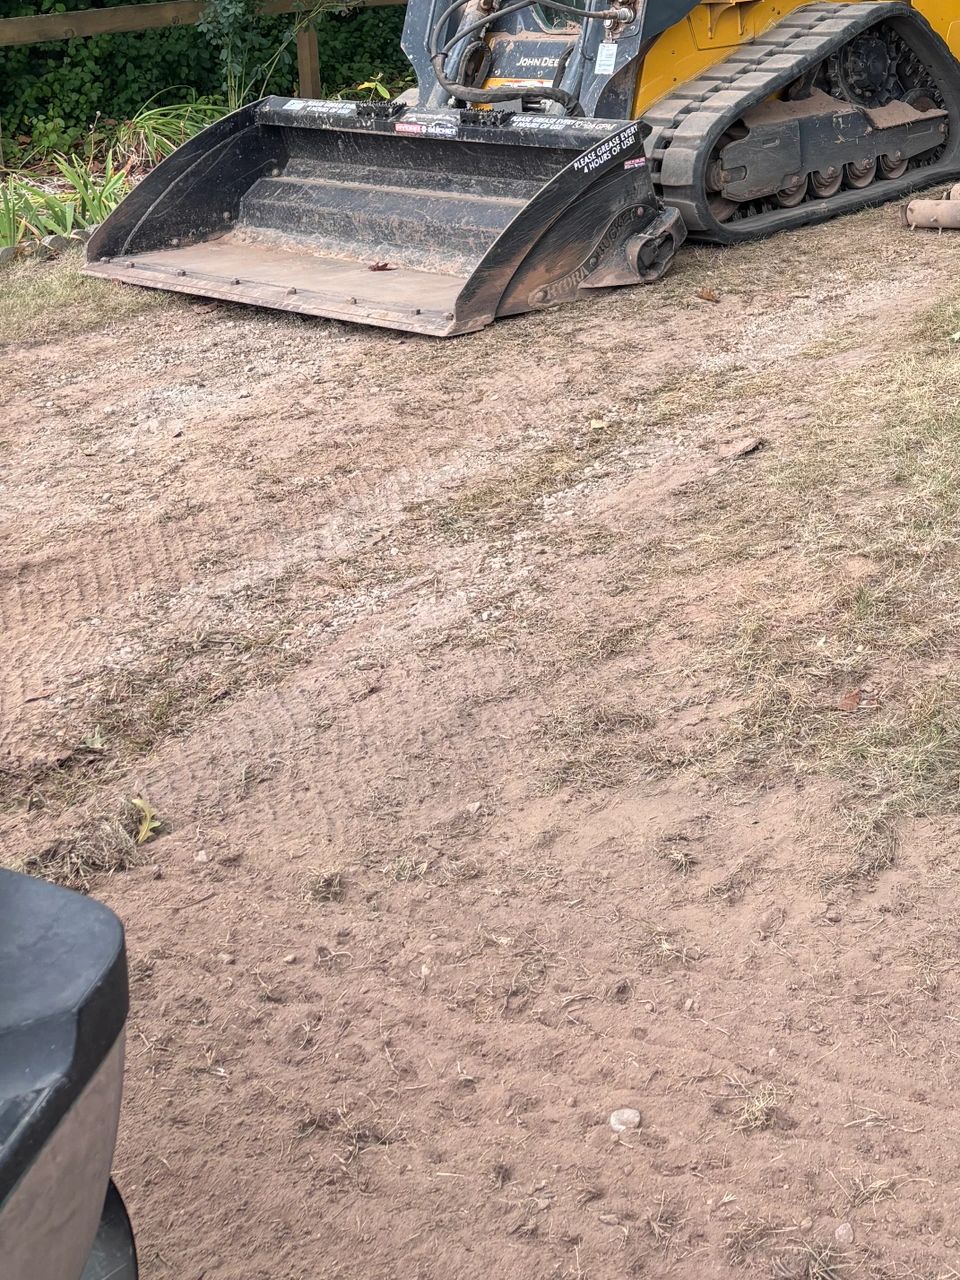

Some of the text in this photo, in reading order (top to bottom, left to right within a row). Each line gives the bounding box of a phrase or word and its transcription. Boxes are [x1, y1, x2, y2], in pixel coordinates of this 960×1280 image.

[516, 57, 542, 67] JOHN
[573, 123, 639, 171] PLEASE GREASE EVERY
[583, 165, 589, 174] 4
[588, 153, 612, 171] HOURS
[611, 145, 621, 155] OF
[620, 135, 636, 149] USE!
